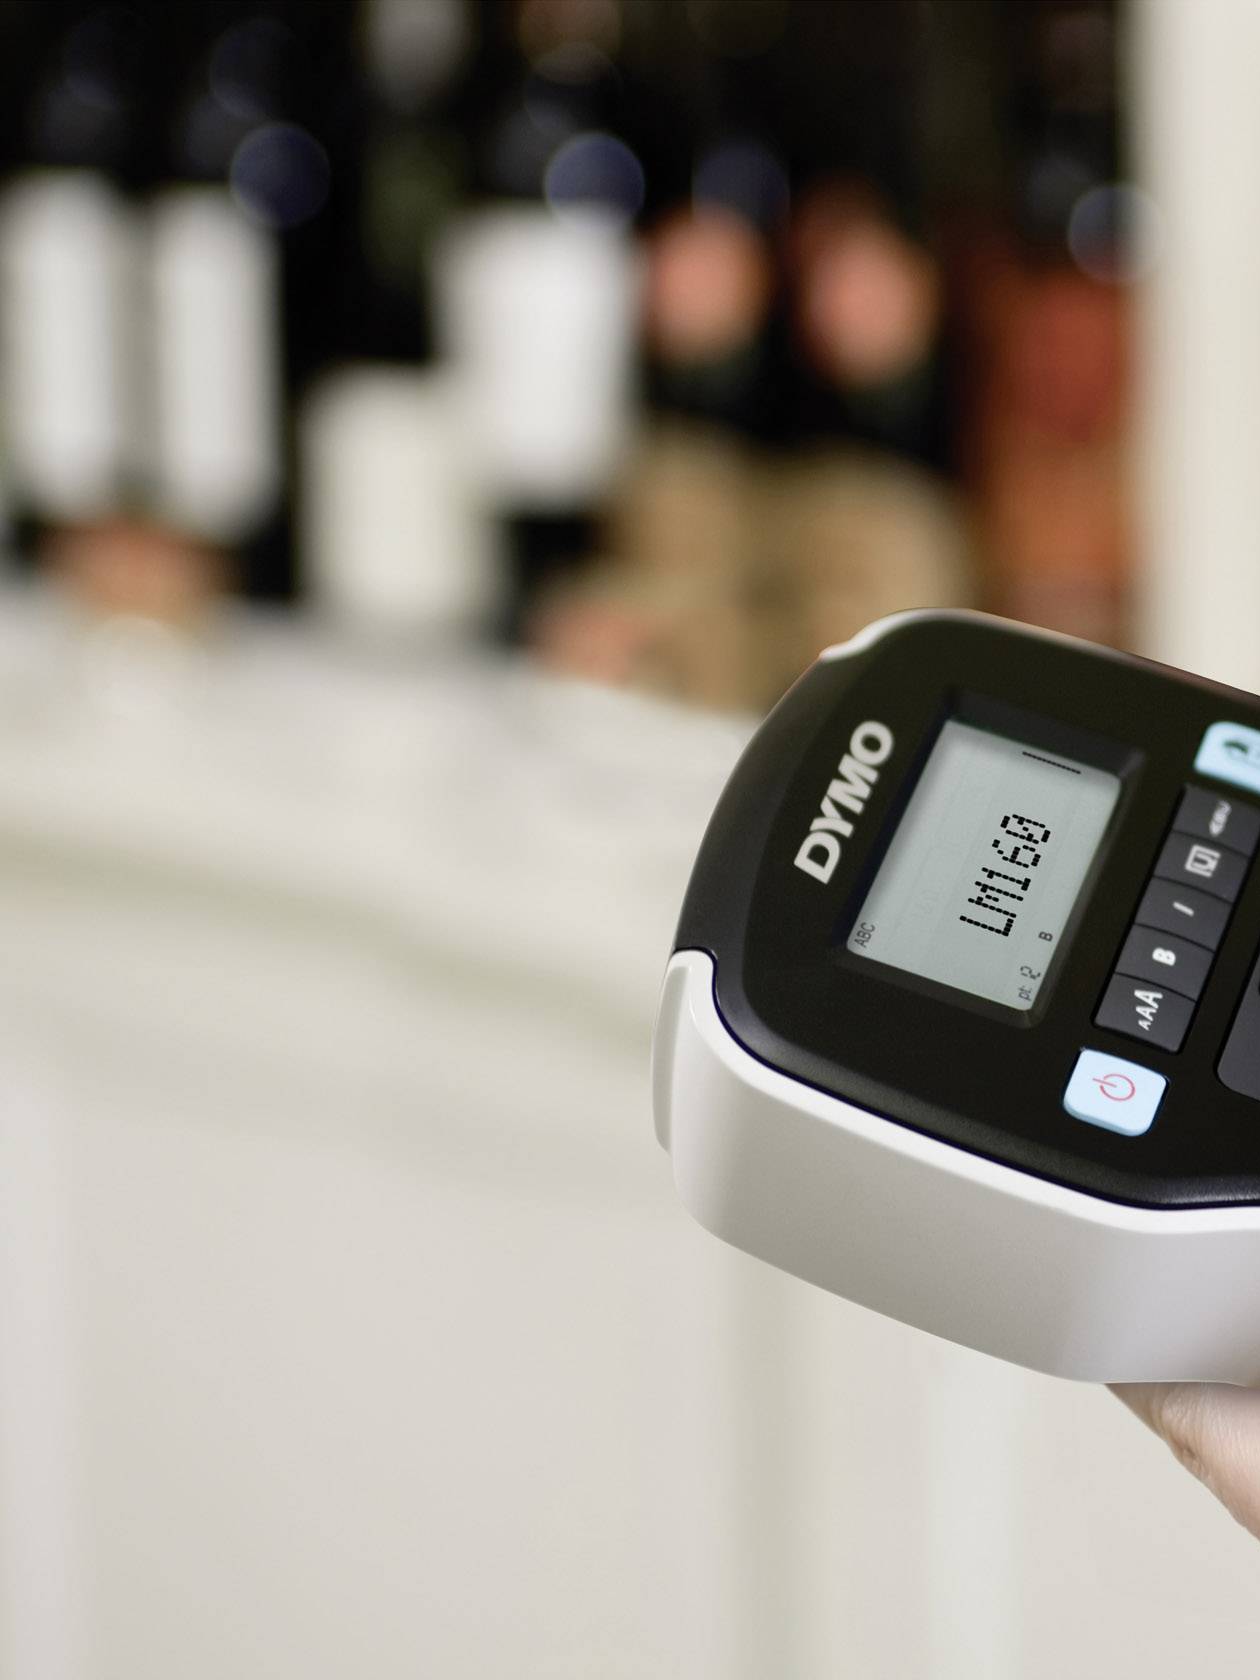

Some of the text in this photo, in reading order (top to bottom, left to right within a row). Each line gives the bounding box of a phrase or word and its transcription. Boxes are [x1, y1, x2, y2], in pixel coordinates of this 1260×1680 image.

[794, 720, 895, 885] DYMO
[959, 814, 1051, 937] LM160
[853, 922, 876, 949] ABC
[1037, 930, 1054, 942] B
[1152, 946, 1177, 966] B
